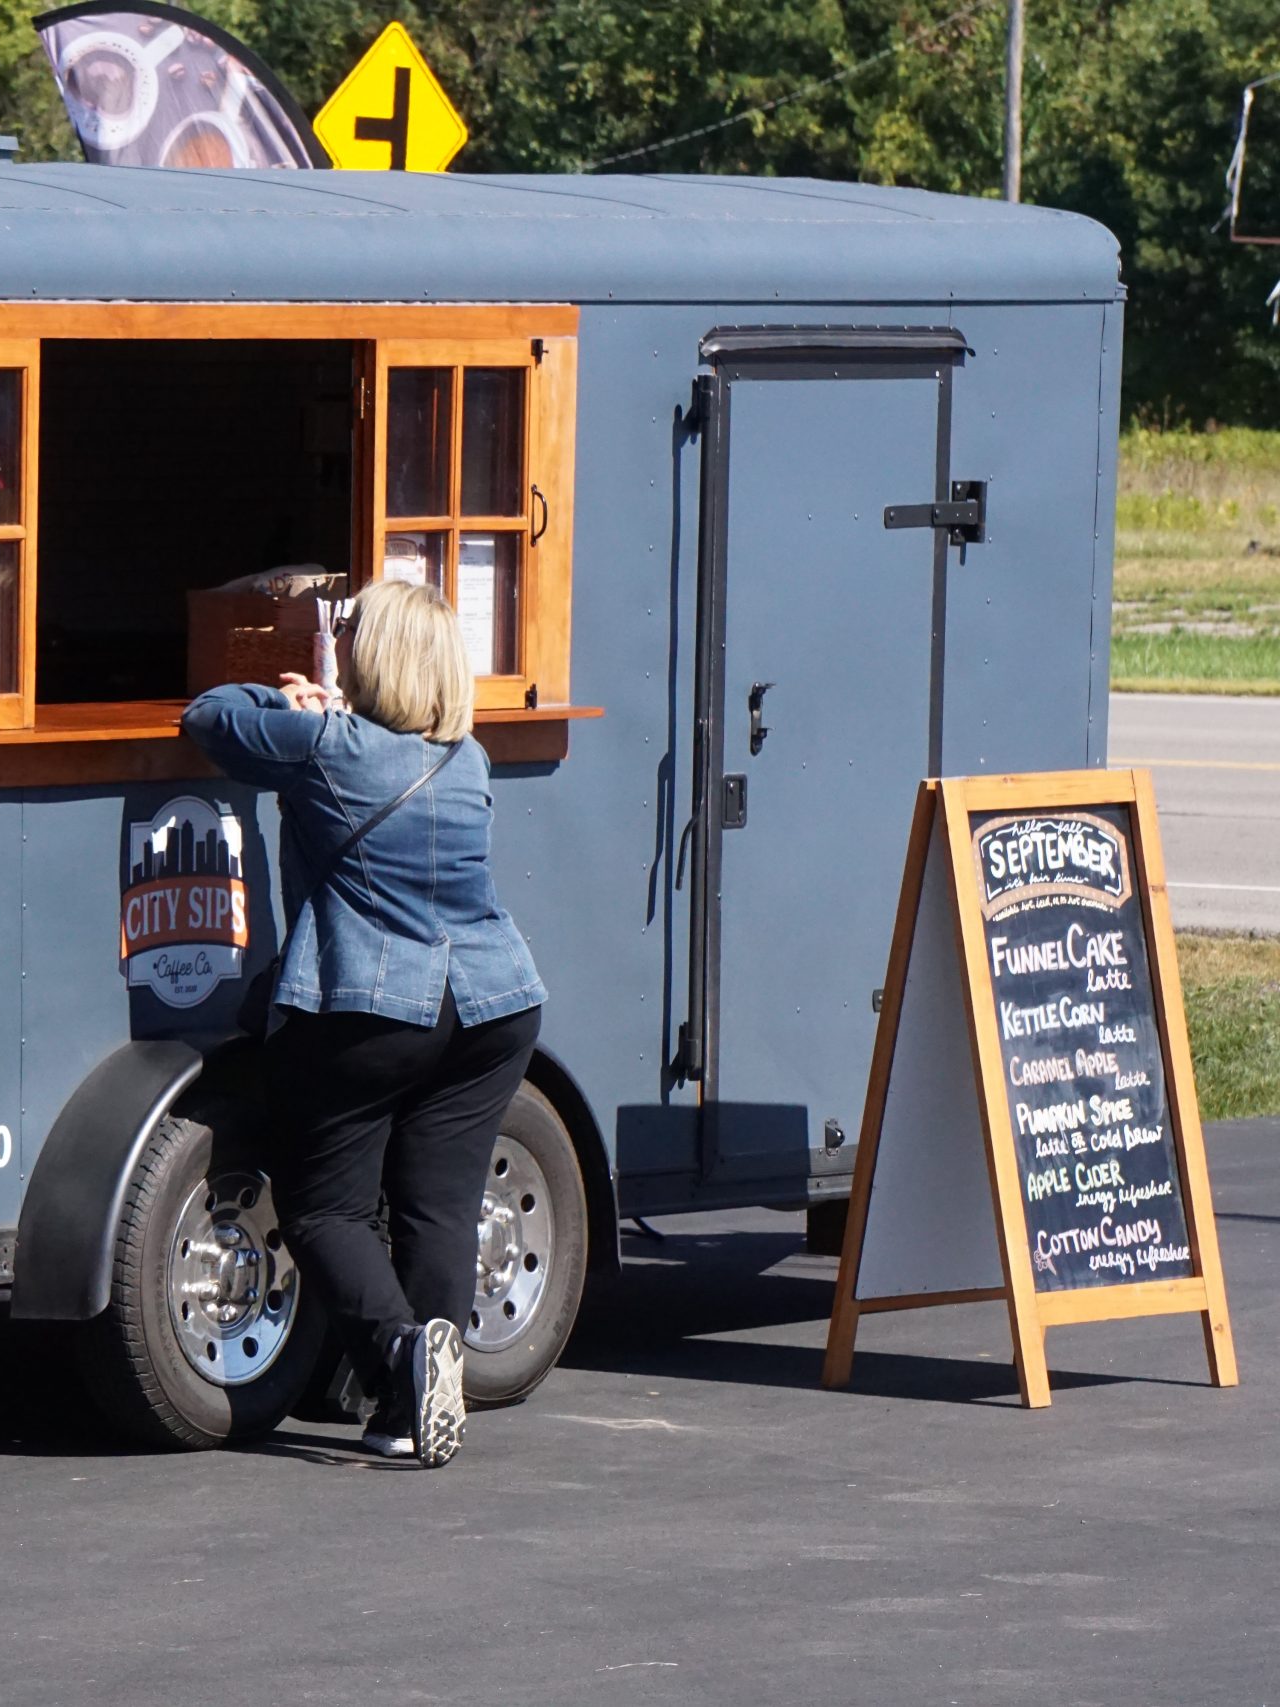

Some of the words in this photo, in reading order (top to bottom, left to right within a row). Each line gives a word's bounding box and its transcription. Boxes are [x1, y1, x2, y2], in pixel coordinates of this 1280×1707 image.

[988, 831, 1116, 879] SEPTEMBER
[125, 887, 181, 941] CITY
[189, 886, 245, 934] SIPS
[157, 952, 193, 984] Coffee
[991, 936, 1069, 977] FUNNEL
[1067, 923, 1127, 968] CAKE
[1086, 968, 1132, 993] latte
[1000, 1001, 1060, 1041] KETTLE
[1059, 996, 1105, 1028] CORN
[1098, 1024, 1137, 1045] latte
[1009, 1055, 1075, 1087] CARAMEL
[1075, 1048, 1119, 1078] APPLE
[1015, 1099, 1087, 1136] PUMPKIN
[1089, 1094, 1134, 1127] SPICE
[1026, 1166, 1072, 1202] APPLE
[1075, 1159, 1125, 1192] CIDER
[1037, 1226, 1100, 1259] COTTON
[1100, 1215, 1162, 1248] CANDY
